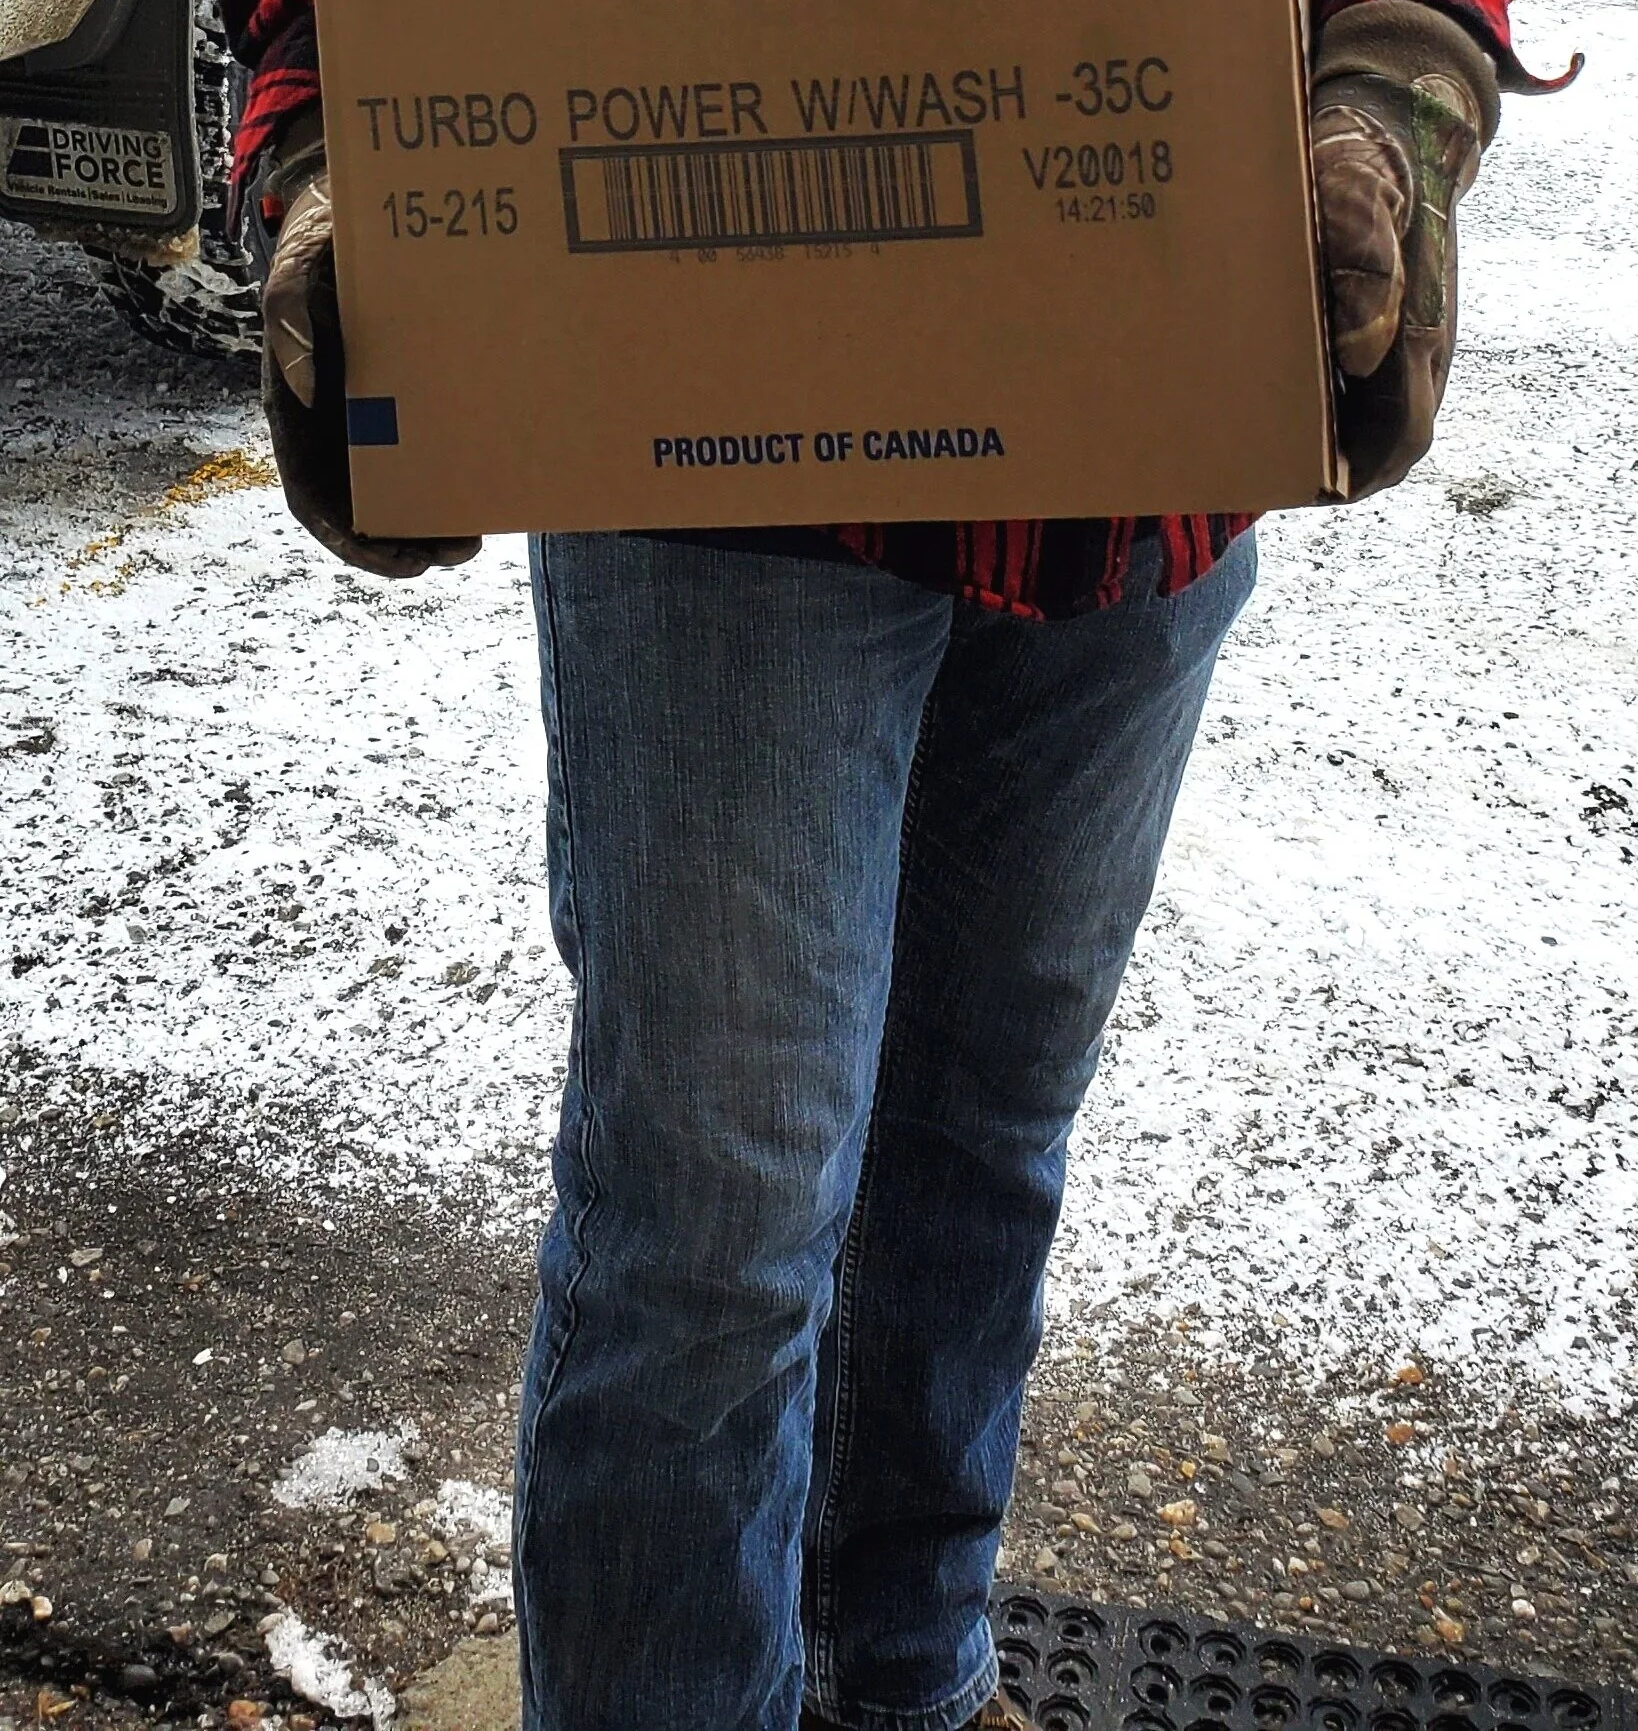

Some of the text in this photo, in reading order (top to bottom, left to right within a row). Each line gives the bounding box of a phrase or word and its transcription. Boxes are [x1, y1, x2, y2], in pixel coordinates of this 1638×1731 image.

[357, 57, 1173, 152] TURBO POWER W/WASH -35C
[53, 128, 162, 159] DRIVING
[55, 151, 166, 189] FORCE
[383, 140, 1174, 238] 15-215 V20018
[48, 184, 87, 199] Rentals
[1055, 192, 1157, 223] 14:21:50
[653, 427, 1005, 468] PRODUCT OF CANADA
